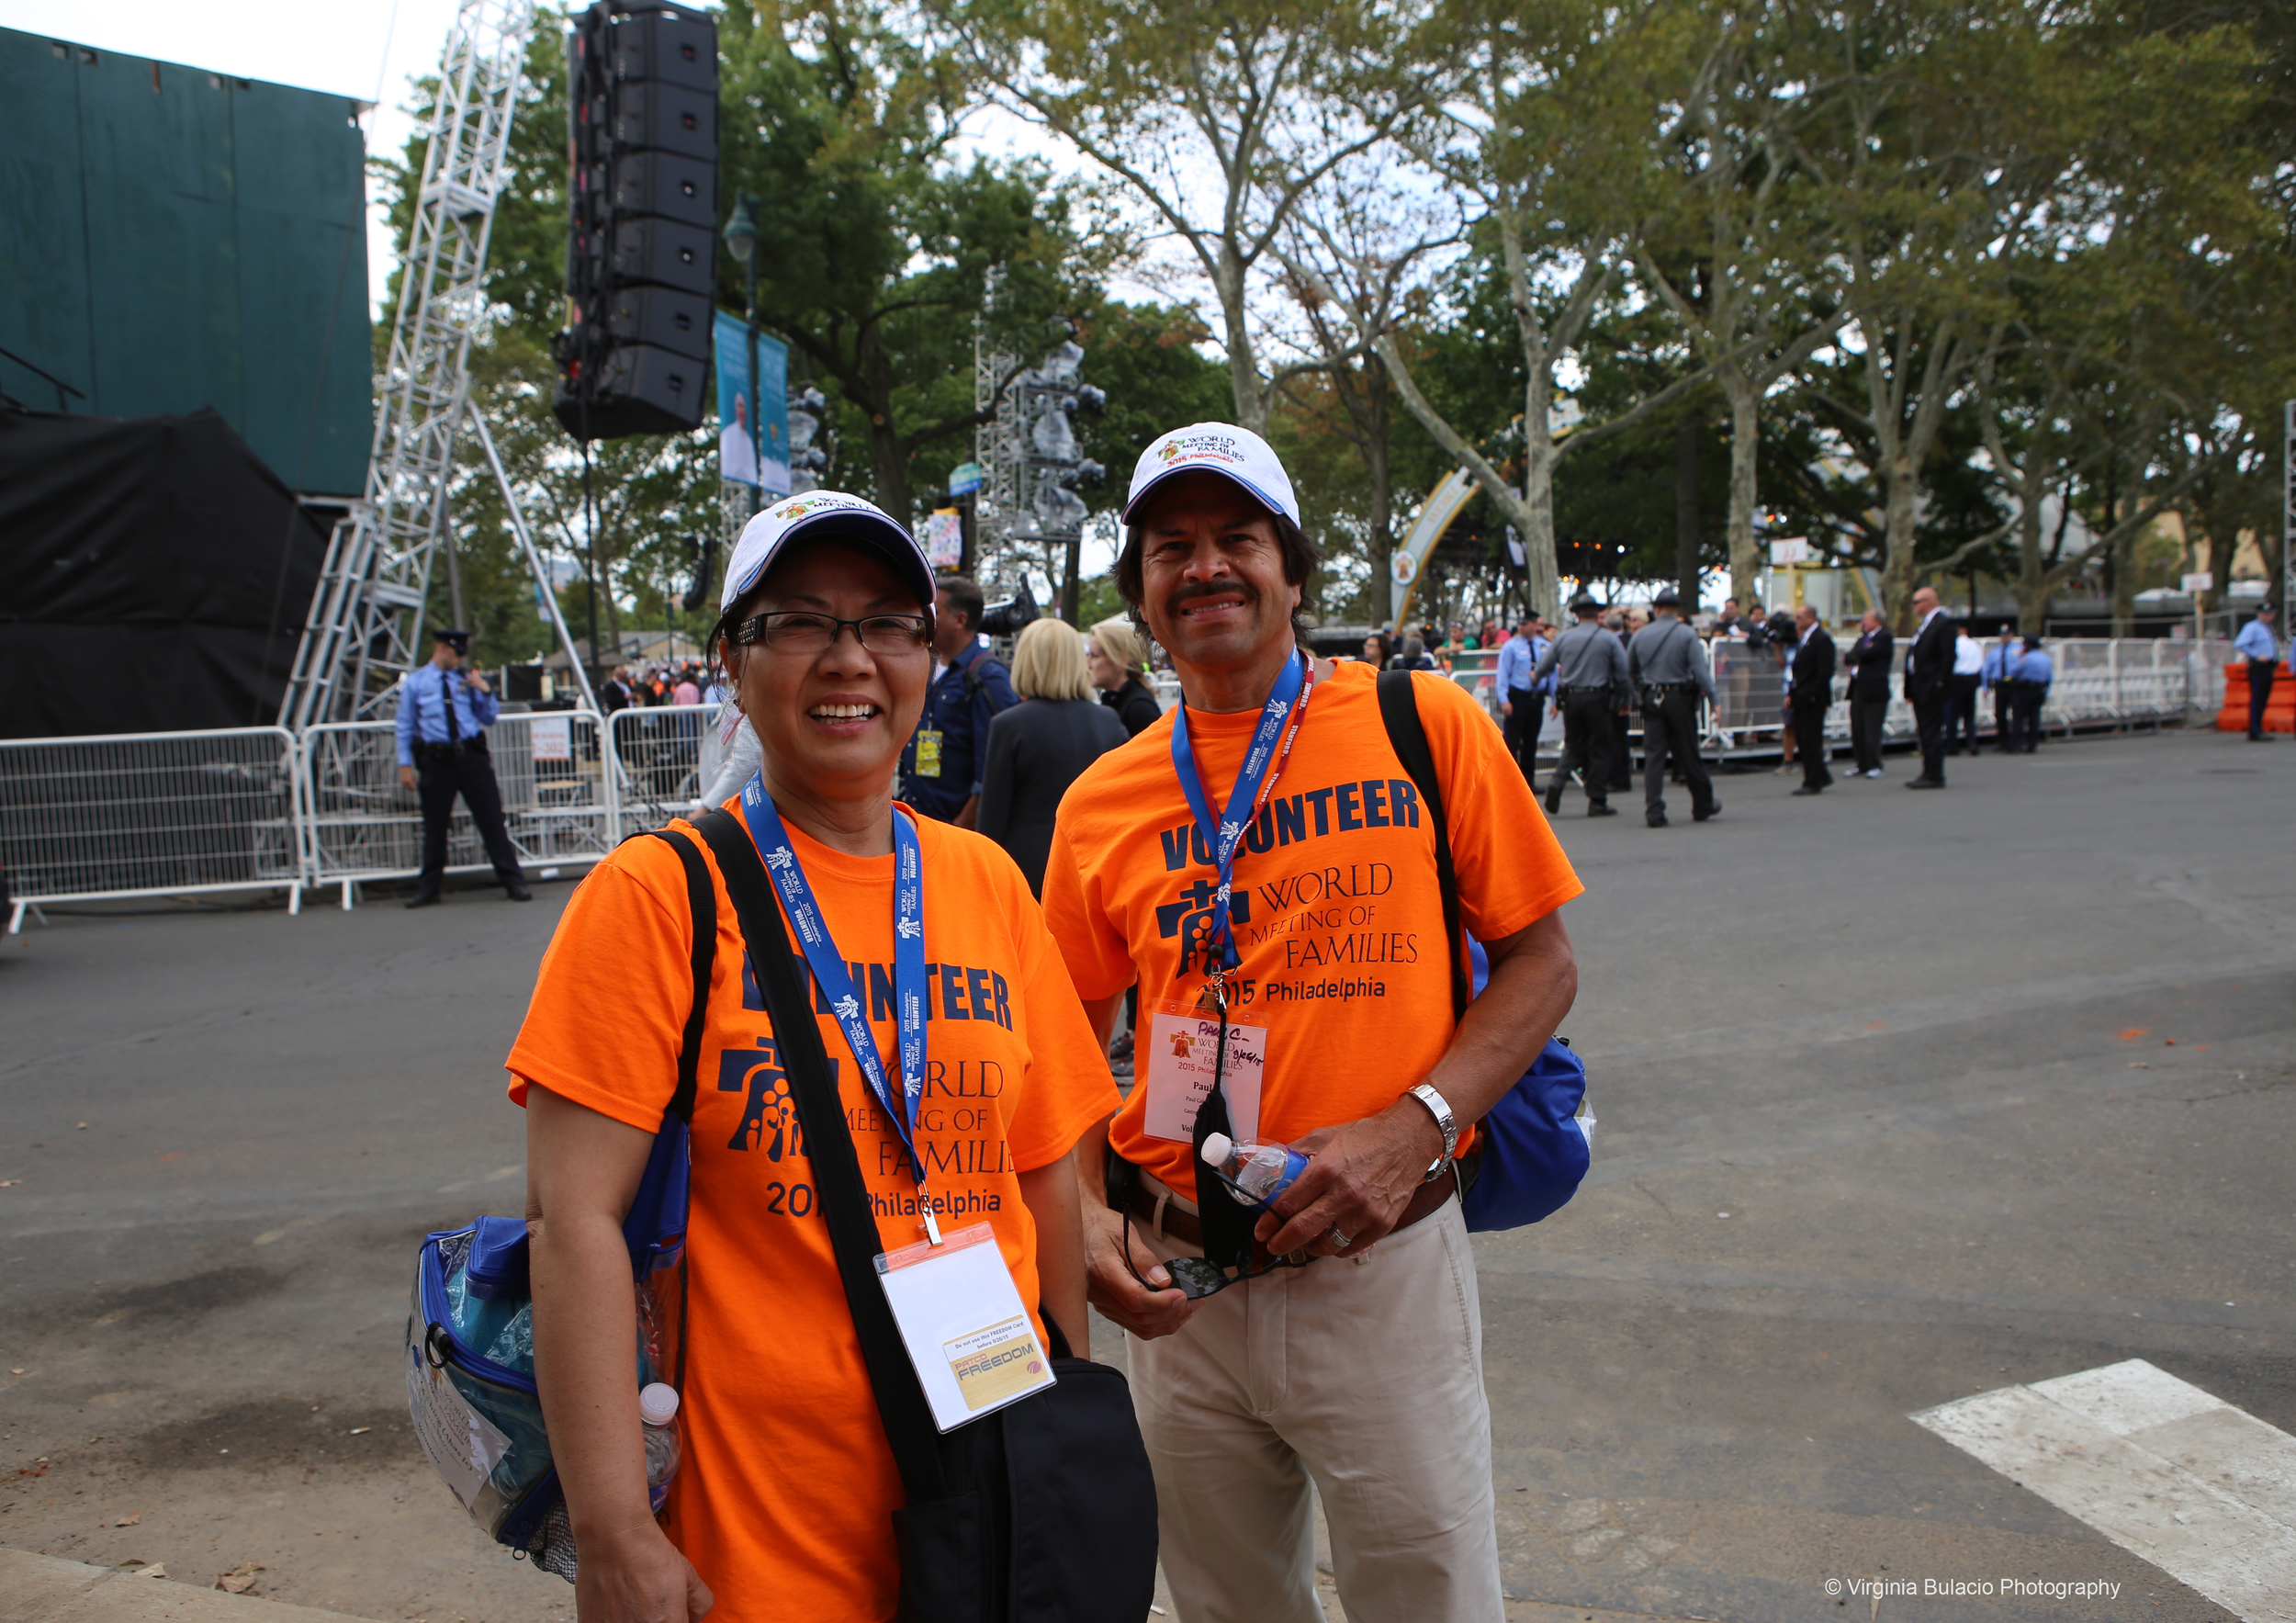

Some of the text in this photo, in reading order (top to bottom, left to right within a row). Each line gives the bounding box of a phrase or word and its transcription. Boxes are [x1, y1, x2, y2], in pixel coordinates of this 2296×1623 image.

[1188, 436, 1235, 445] WORLD
[1198, 447, 1245, 462] FAMILIES
[1245, 747, 1261, 774] VOLUNTEER
[780, 878, 796, 903] FAMILIES
[789, 870, 803, 894] WORLD
[1258, 863, 1393, 912] WORLD
[803, 902, 813, 916] 2015
[794, 908, 814, 943] VOLUNTEER
[1249, 906, 1376, 946] MEETING OF
[1285, 933, 1418, 969] FAMILIES
[1266, 976, 1386, 1002] Philadelphia
[850, 1029, 864, 1056] FAMILIES
[856, 1021, 869, 1047] WORLD
[870, 1056, 878, 1071] 2015
[1178, 1061, 1195, 1072] 2015
[1204, 1056, 1243, 1070] FAILIES
[1193, 1082, 1212, 1092] Paul
[954, 1109, 988, 1131] OF
[990, 1325, 1012, 1337] FREEDOM
[955, 1353, 987, 1370] PATCO
[958, 1343, 1034, 1381] FREEDOM
